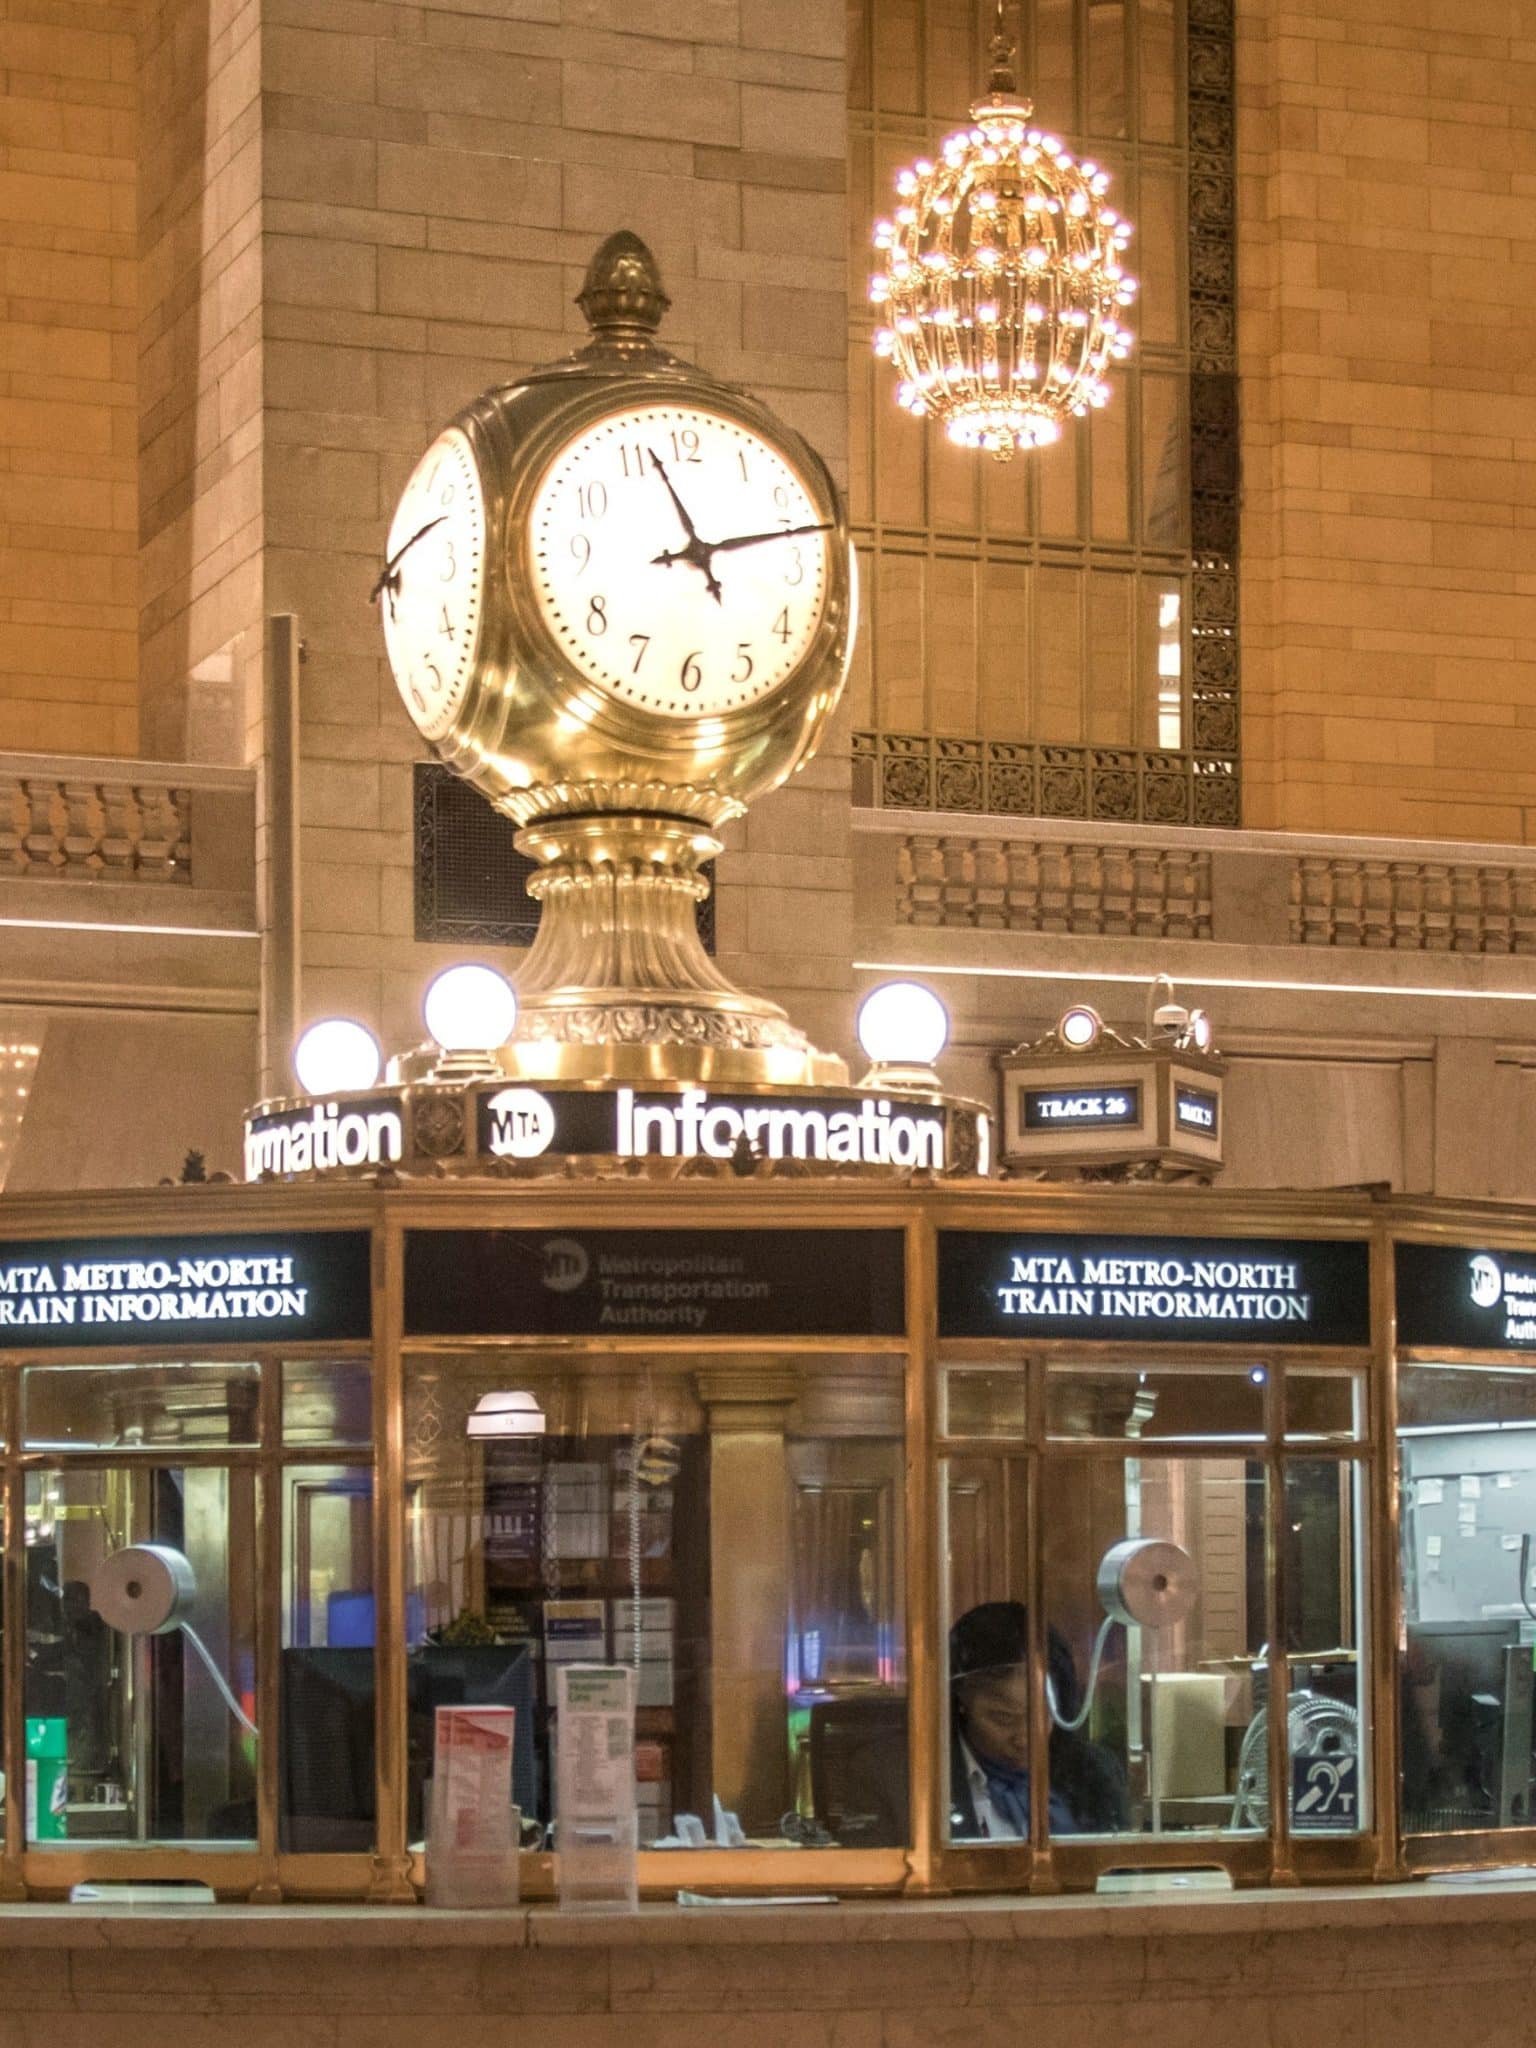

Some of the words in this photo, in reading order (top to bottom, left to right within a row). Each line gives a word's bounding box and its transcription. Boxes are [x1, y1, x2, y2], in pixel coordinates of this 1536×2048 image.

[620, 443, 645, 478] 11
[671, 430, 703, 463] 12
[738, 450, 749, 483] 1
[577, 481, 608, 519] 10
[571, 534, 591, 576] 9
[784, 546, 803, 586] 3
[439, 604, 455, 641] 4
[586, 595, 608, 637] 8
[771, 605, 793, 645] 4
[629, 634, 651, 674] 7
[681, 651, 704, 692] 6
[732, 643, 754, 683] 5
[1038, 1099, 1103, 1118] TRACK
[1105, 1097, 1126, 1115] 26
[616, 1088, 944, 1169] Information
[0, 1265, 57, 1293] MTA
[62, 1258, 293, 1291] METRO-NORTH
[600, 1255, 745, 1277] Metropolitan
[1010, 1257, 1075, 1284] MTA
[1081, 1260, 1297, 1290] METRO-NORTH
[0, 1296, 77, 1324] RAIN
[81, 1288, 307, 1322] INFORMATION
[602, 1279, 770, 1301] Transportation
[998, 1288, 1095, 1316] TRAIN
[1099, 1290, 1310, 1321] INFORMATION
[600, 1304, 709, 1328] Authority
[1338, 1793, 1354, 1812] T
